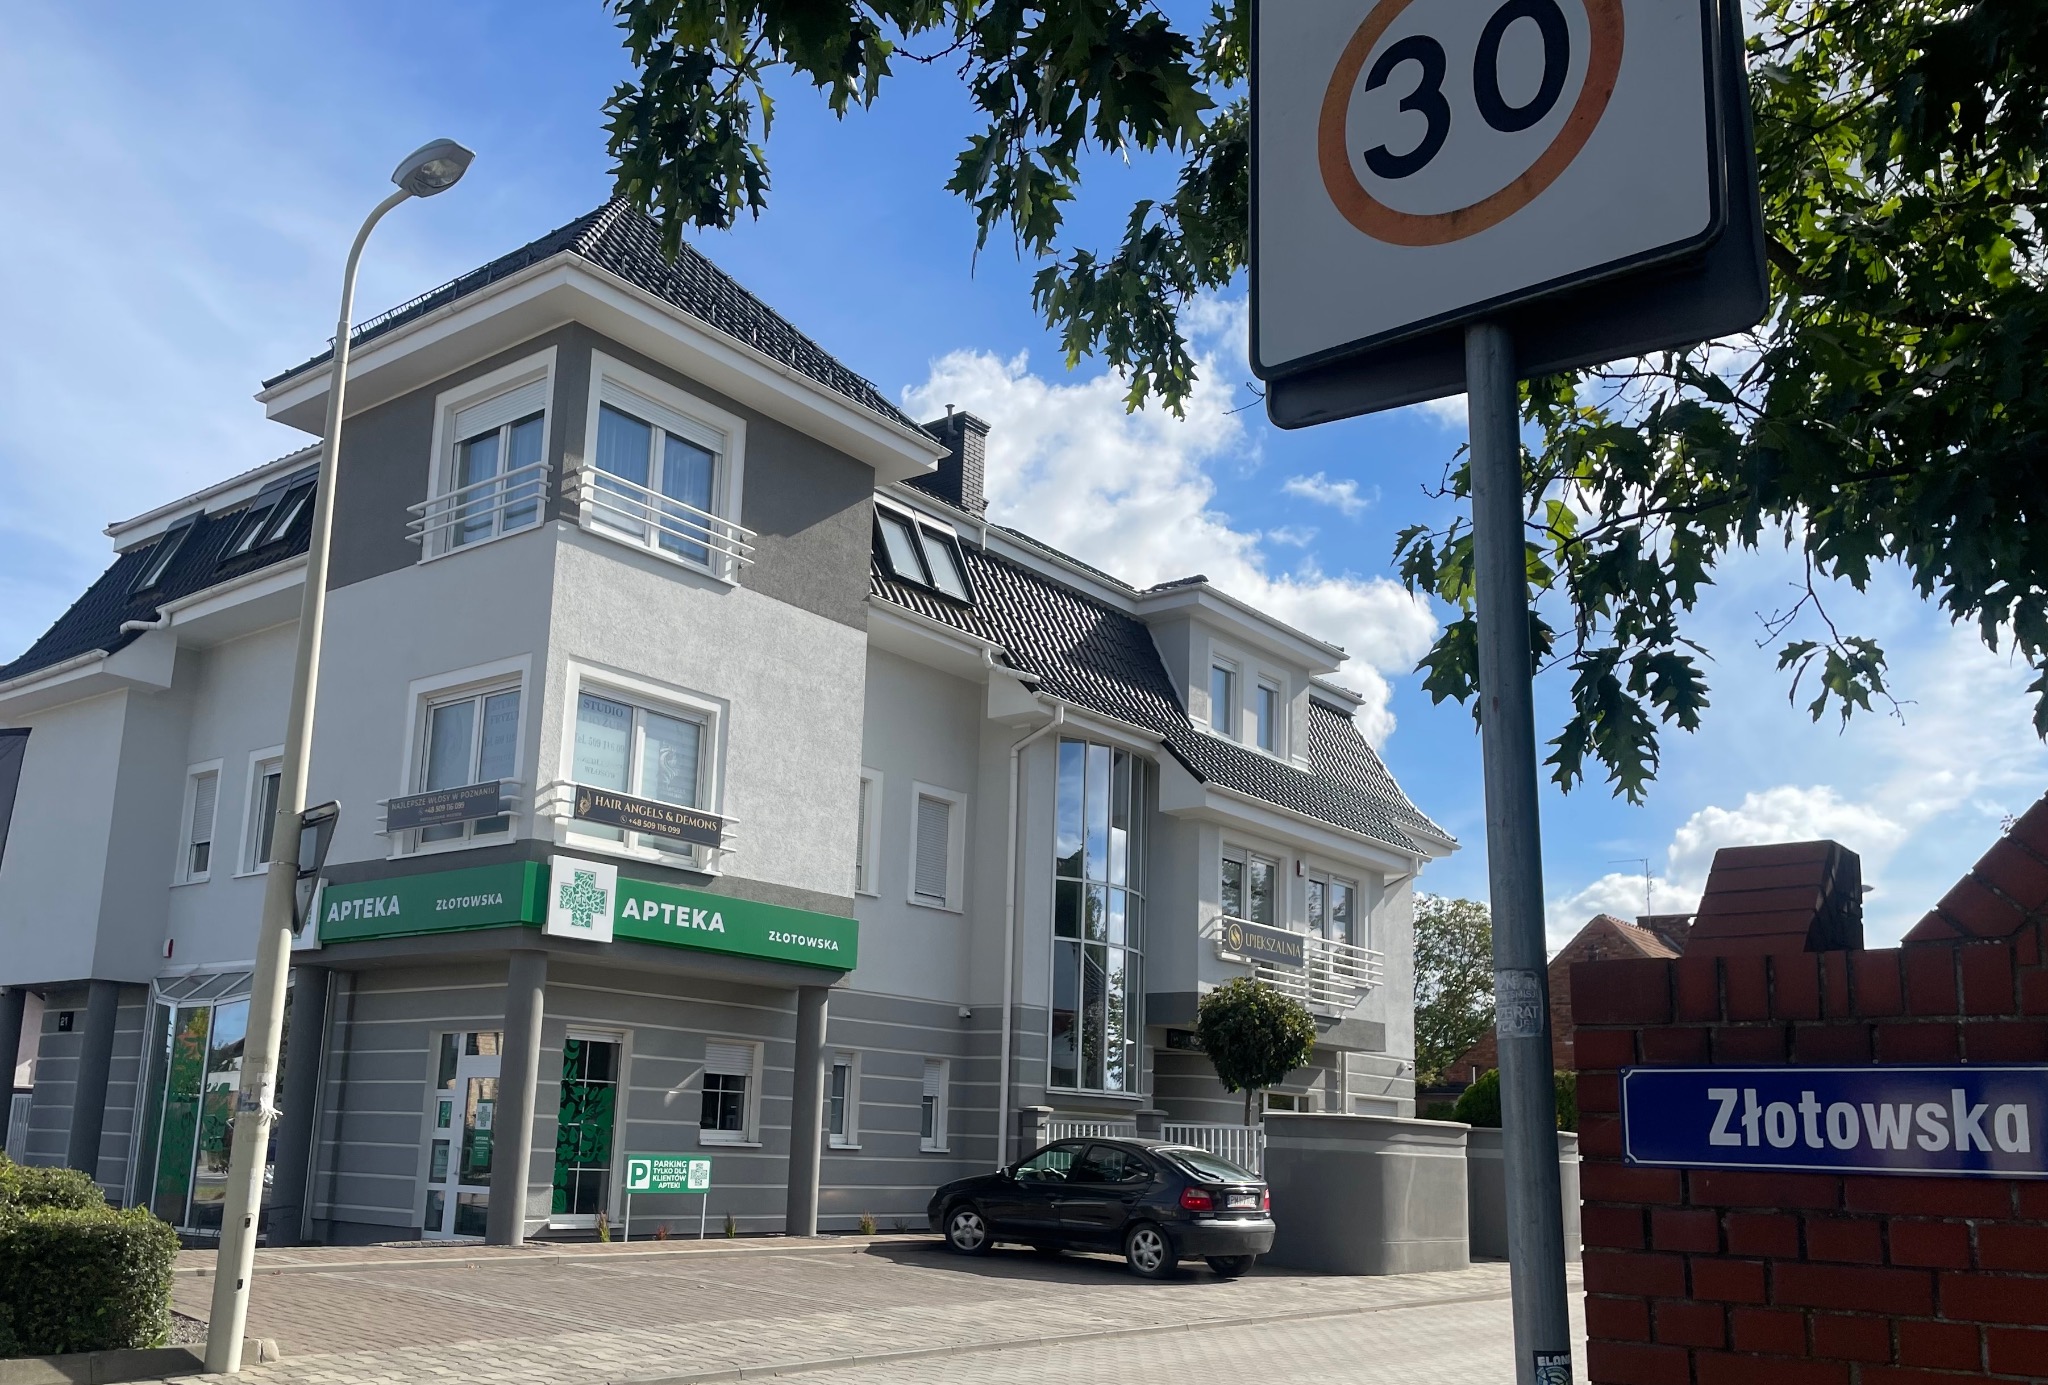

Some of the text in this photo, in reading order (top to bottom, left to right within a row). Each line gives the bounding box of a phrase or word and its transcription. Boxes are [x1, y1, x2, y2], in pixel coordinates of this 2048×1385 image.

[1363, 0, 1571, 179] 30
[582, 699, 624, 718] STUDIO
[391, 786, 496, 811] NAJLEPSZE WŁOSY W POZNANIU
[595, 795, 717, 832] HAIR ANGELS & DEMONS
[628, 817, 681, 835] +48 509 116 099
[326, 892, 503, 923] APTEKA ZŁOTOWSKA
[621, 897, 839, 951] APTEKA ZŁOTOWSKA
[1707, 1088, 2031, 1153] Złotowska
[630, 1162, 648, 1187] P
[652, 1167, 673, 1175] TYLKO
[653, 1160, 687, 1168] PARKING
[652, 1173, 687, 1182] KLIENTÓW
[1537, 1354, 1570, 1367] ELAN
